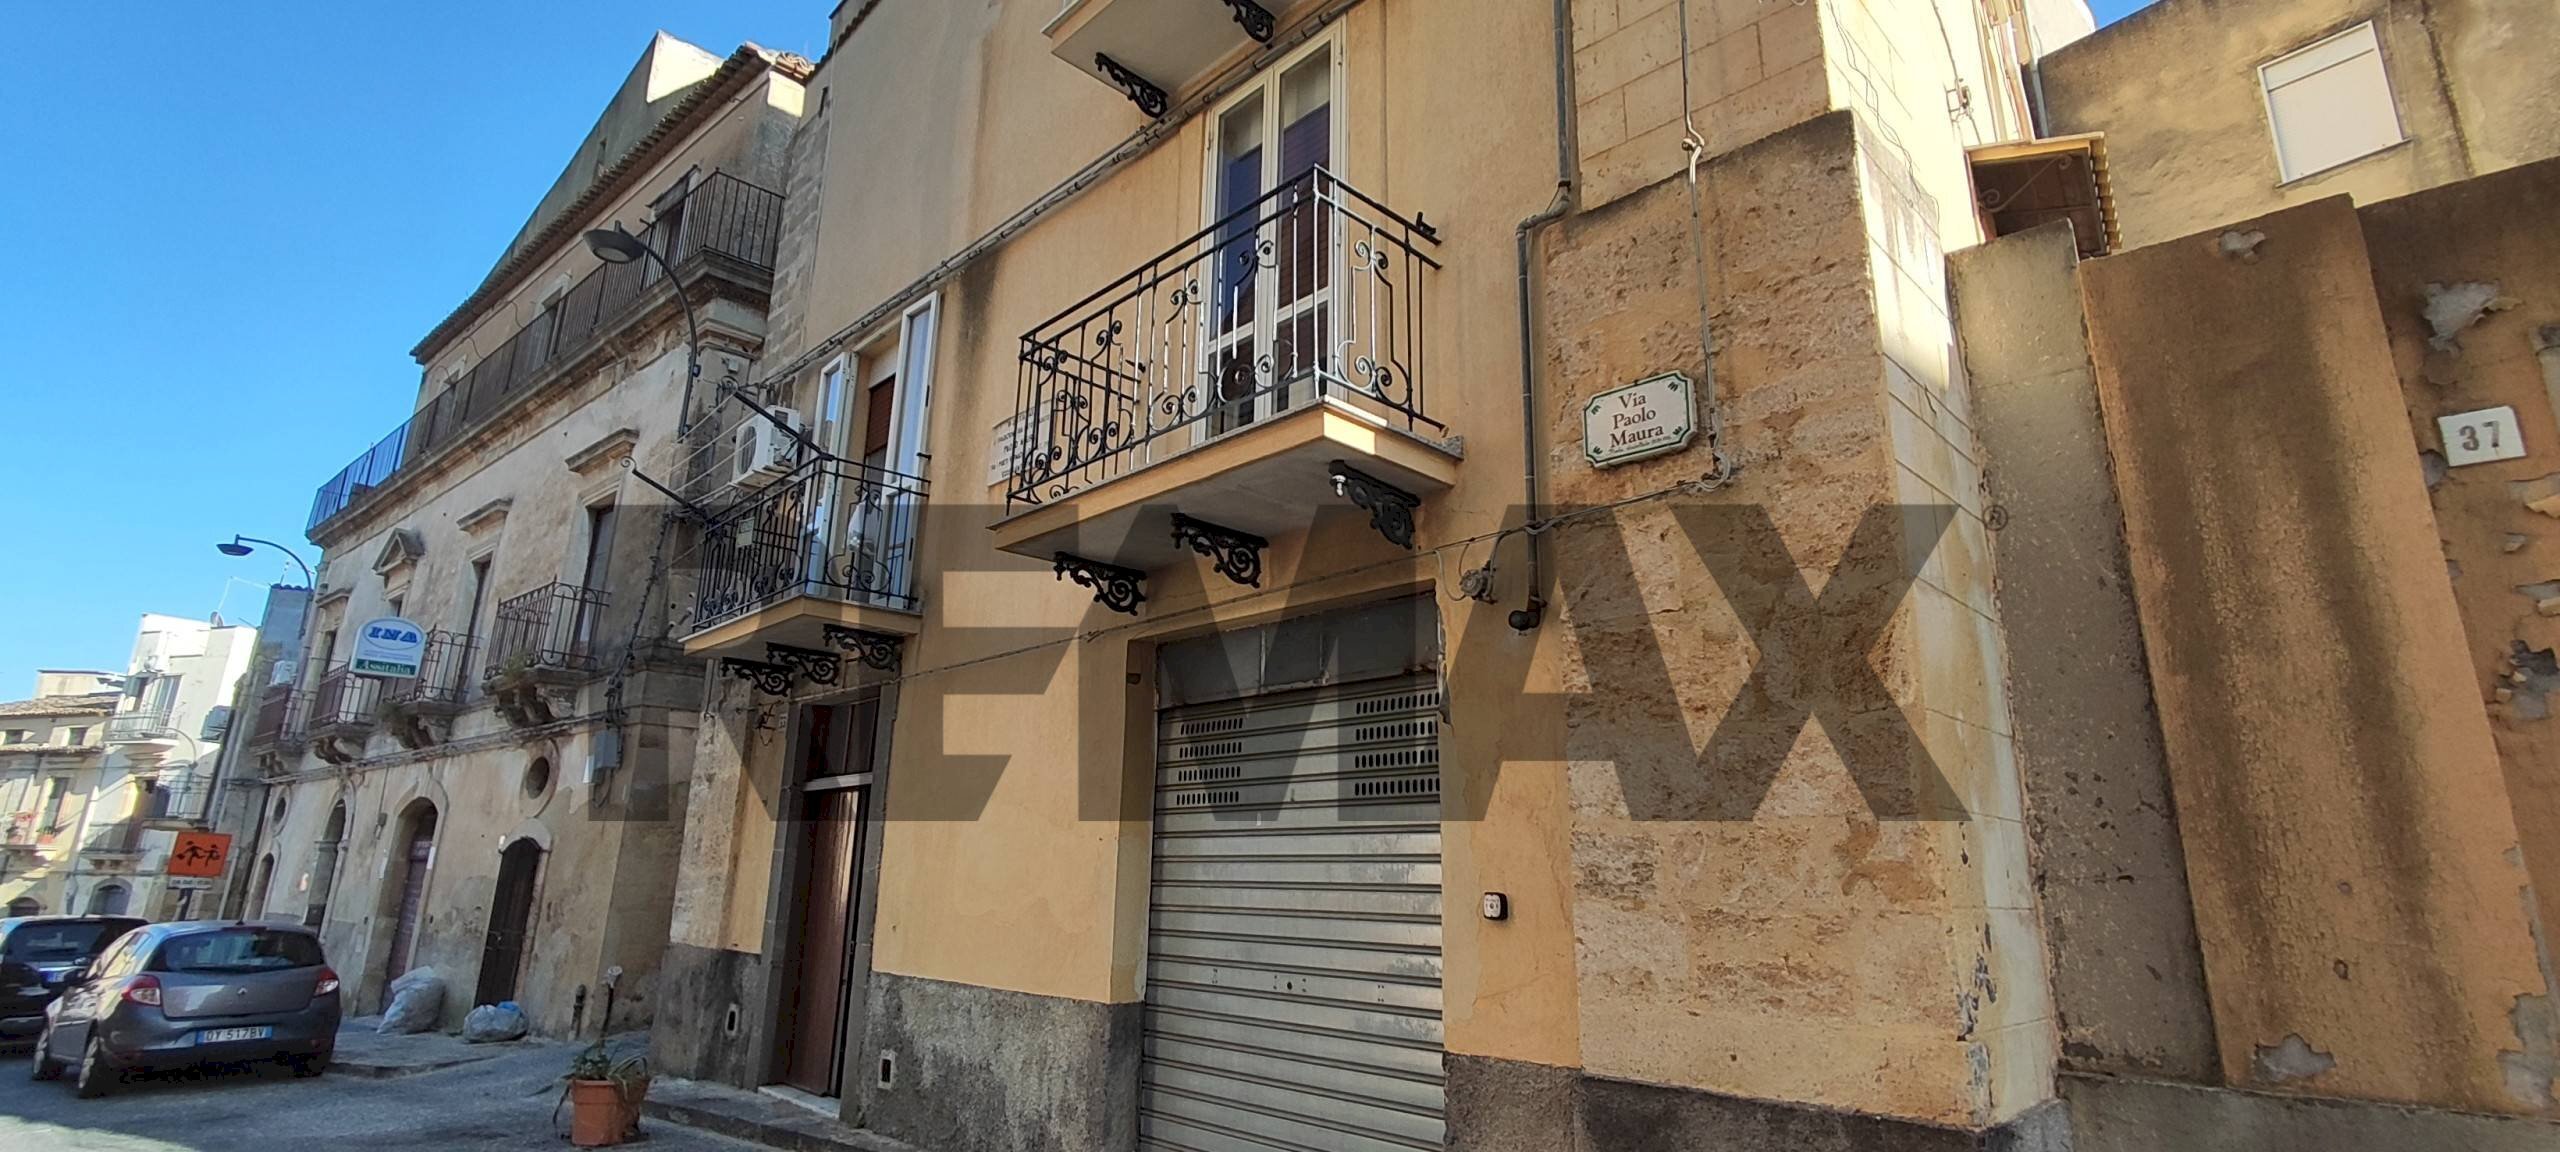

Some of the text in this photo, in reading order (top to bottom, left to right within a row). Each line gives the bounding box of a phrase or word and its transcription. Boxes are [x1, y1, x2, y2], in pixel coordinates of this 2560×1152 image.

[1619, 392, 1647, 409] Via
[1612, 407, 1657, 430] Paolo
[1609, 425, 1665, 448] Maura
[2459, 420, 2500, 451] 37
[368, 626, 417, 643] INA
